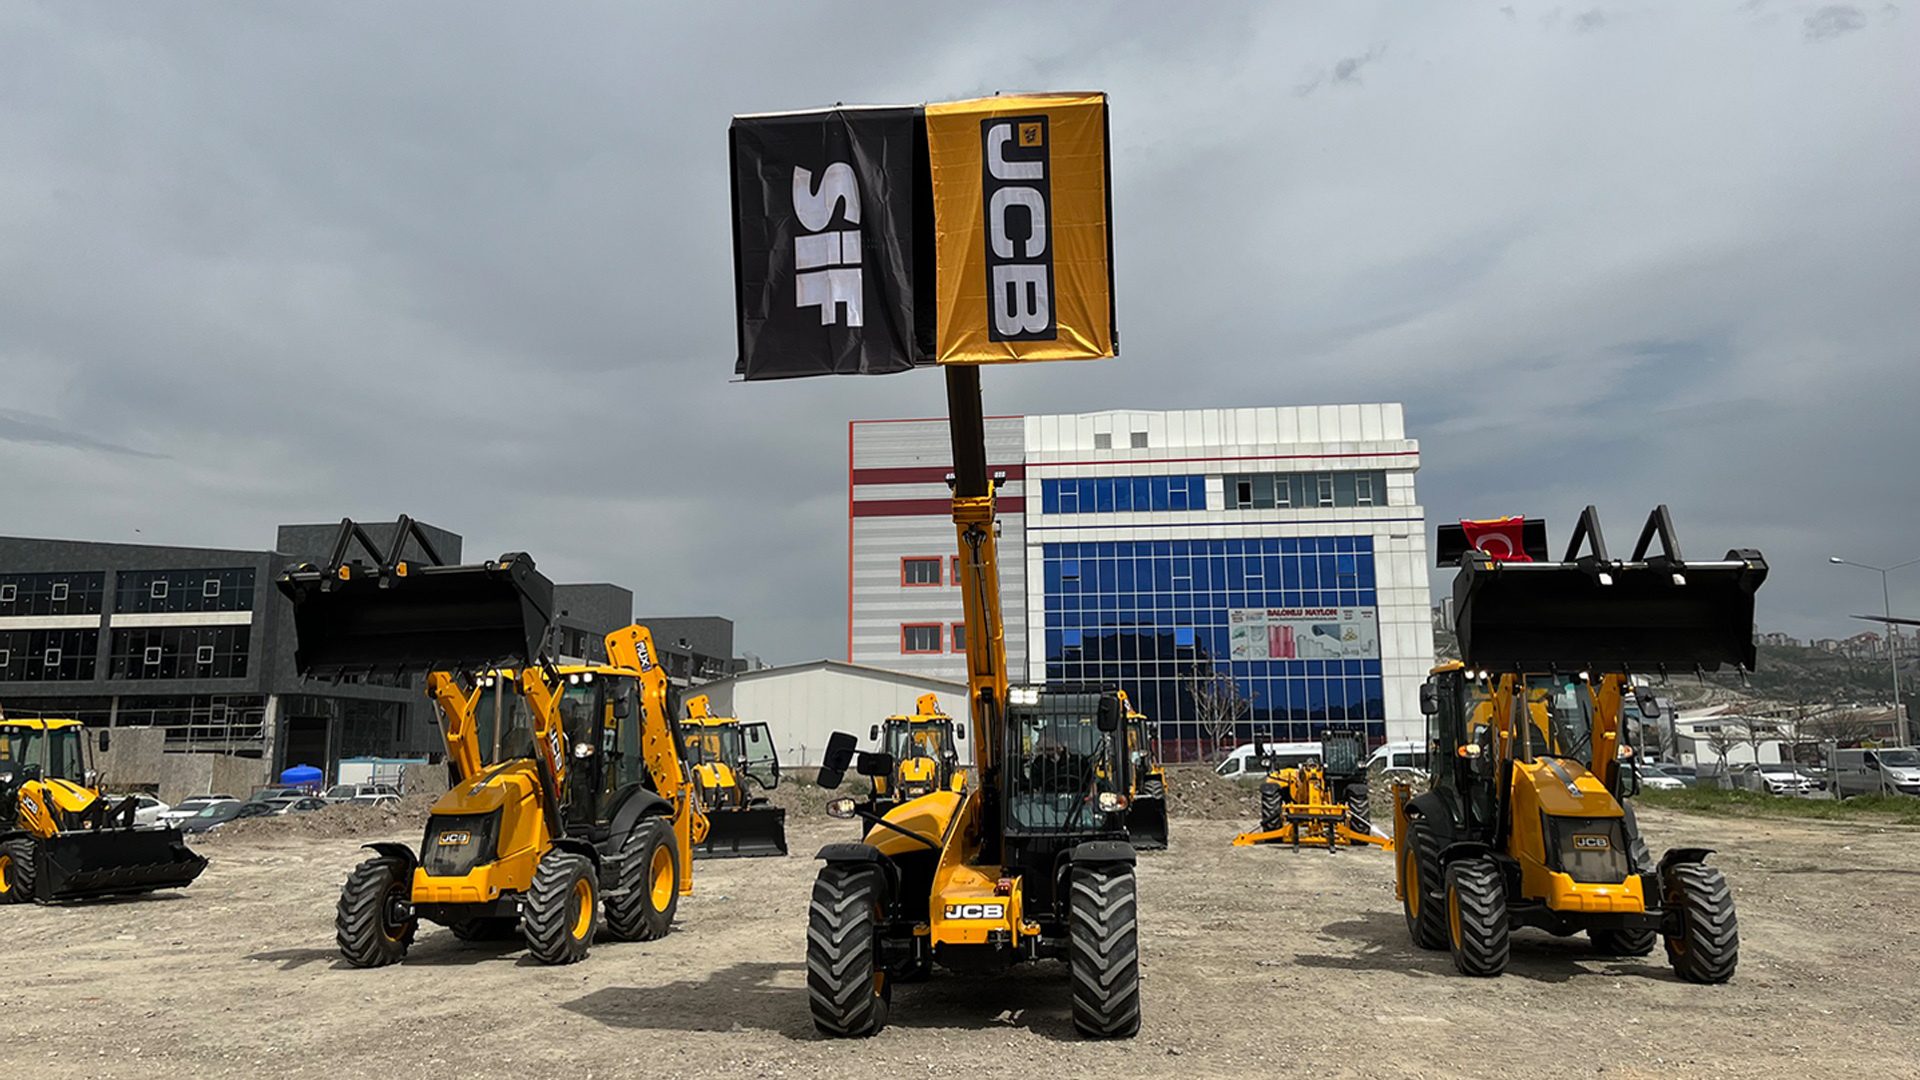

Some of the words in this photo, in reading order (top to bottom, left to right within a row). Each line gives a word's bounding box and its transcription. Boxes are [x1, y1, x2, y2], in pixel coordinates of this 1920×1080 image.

[987, 123, 1050, 336] JCB
[1305, 608, 1337, 616] NAYLON
[549, 727, 562, 771] JCB
[22, 796, 39, 815] JCB
[441, 833, 467, 842] JCB
[1577, 838, 1608, 847] JCB
[945, 904, 1003, 919] JCB
